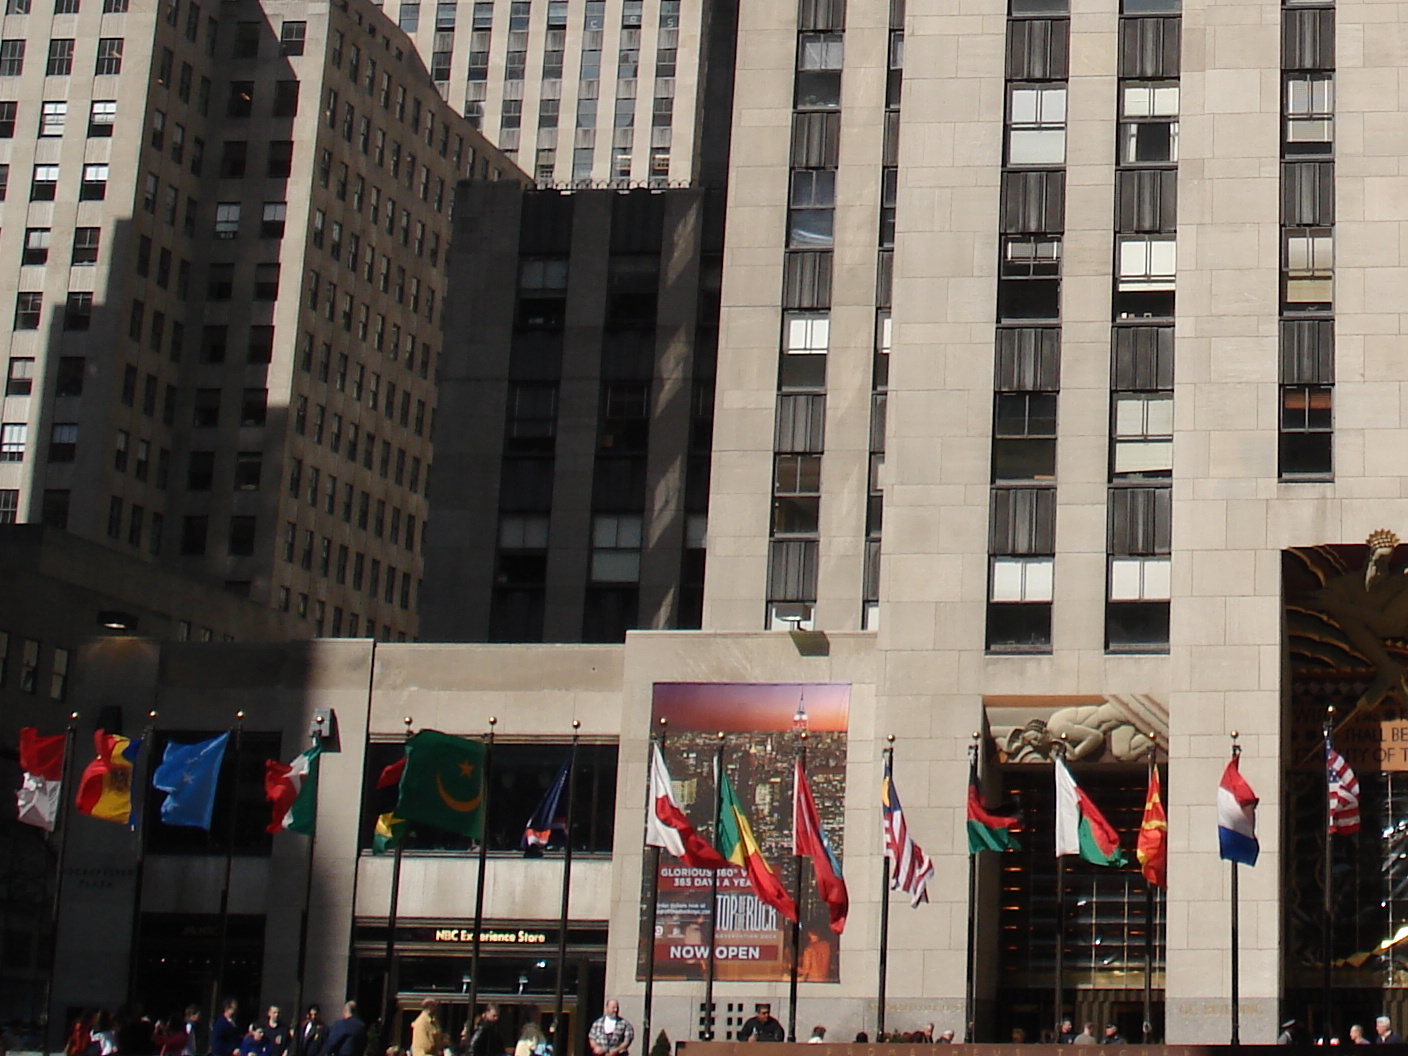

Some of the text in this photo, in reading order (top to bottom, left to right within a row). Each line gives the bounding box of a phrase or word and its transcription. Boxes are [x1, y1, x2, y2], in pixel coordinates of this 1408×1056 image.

[1392, 727, 1408, 741] BE
[1373, 747, 1395, 762] OF
[661, 868, 712, 877] GLORIOUS
[674, 878, 692, 887] 365
[722, 878, 732, 887] A
[716, 895, 738, 931] TOP
[436, 930, 546, 943] NBC Exerience Store
[669, 945, 760, 959] NOW OPEN
